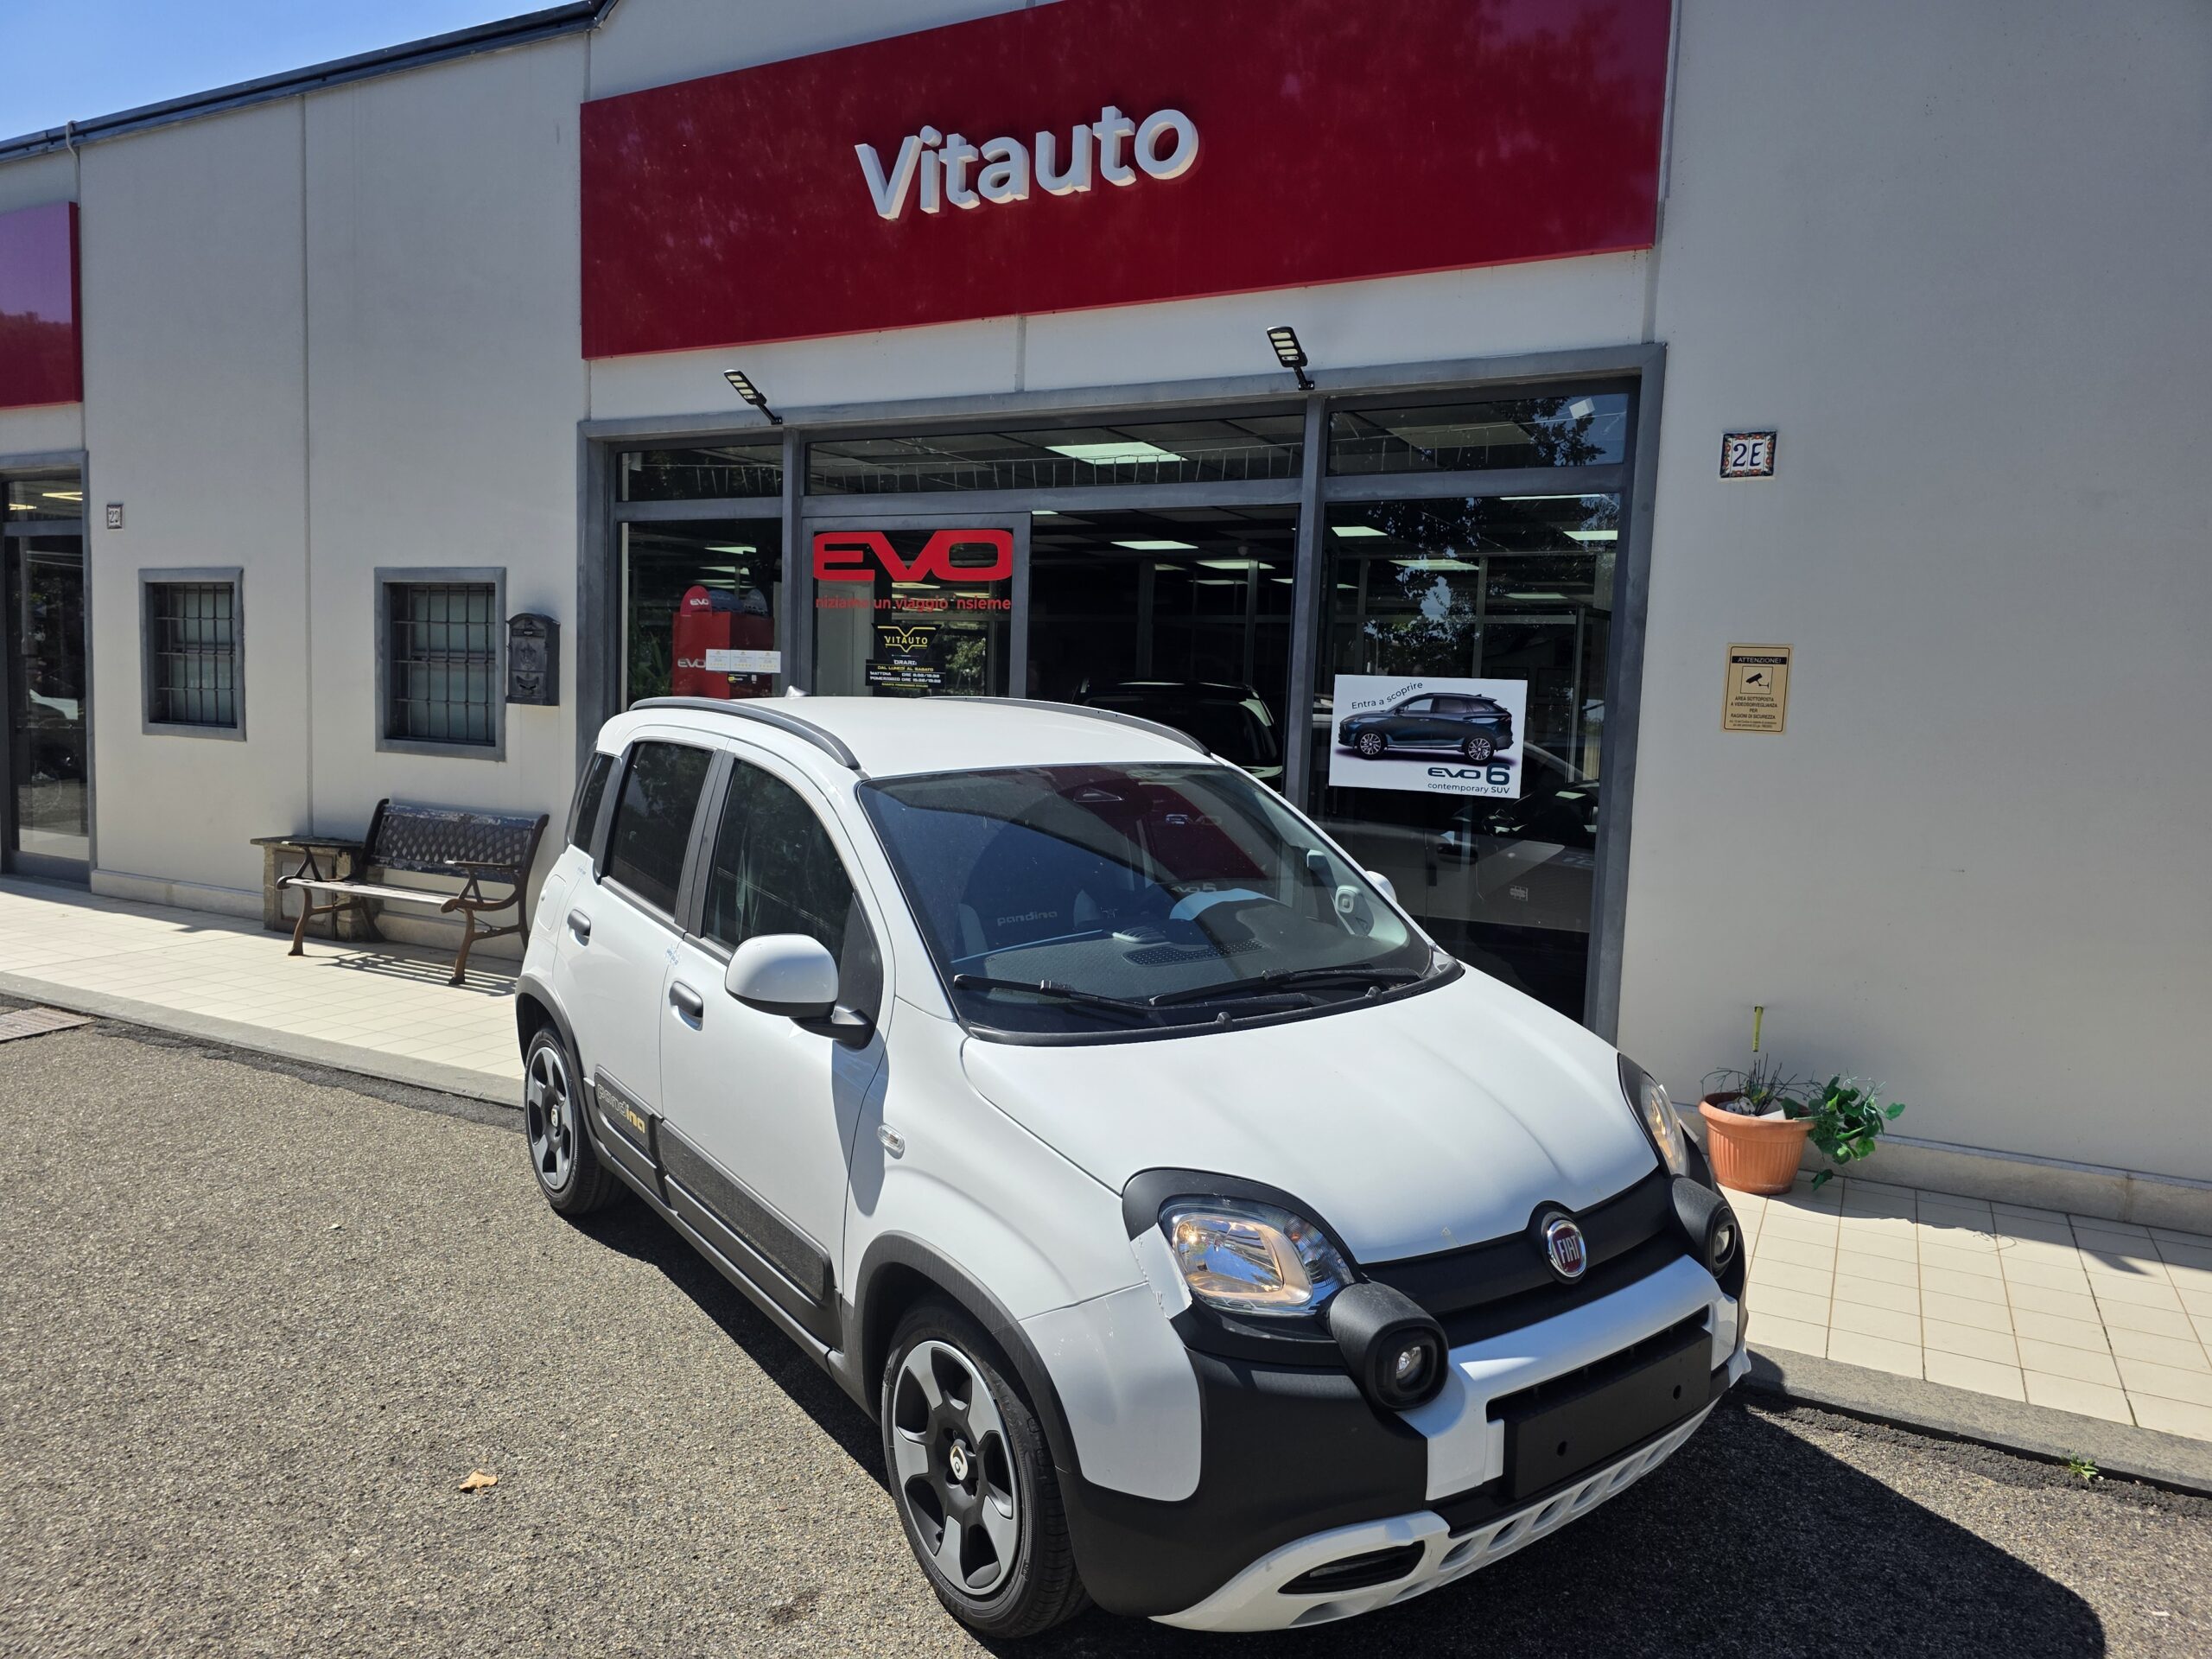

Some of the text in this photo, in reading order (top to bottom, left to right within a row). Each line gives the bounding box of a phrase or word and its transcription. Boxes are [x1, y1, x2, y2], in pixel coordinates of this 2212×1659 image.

[855, 105, 1199, 220] Vitauto
[1732, 442, 1764, 467] 2E
[813, 529, 1013, 582] EVO
[874, 598, 891, 609] un
[896, 594, 948, 613] viaggio
[953, 594, 1011, 609] nsieme
[884, 636, 928, 645] VITAUTO
[1351, 700, 1376, 709] Entra
[1386, 682, 1423, 702] scoprire
[1427, 762, 1510, 785] EVO 6
[1427, 783, 1489, 793] contemporary
[1557, 1235, 1580, 1264] FIAT
